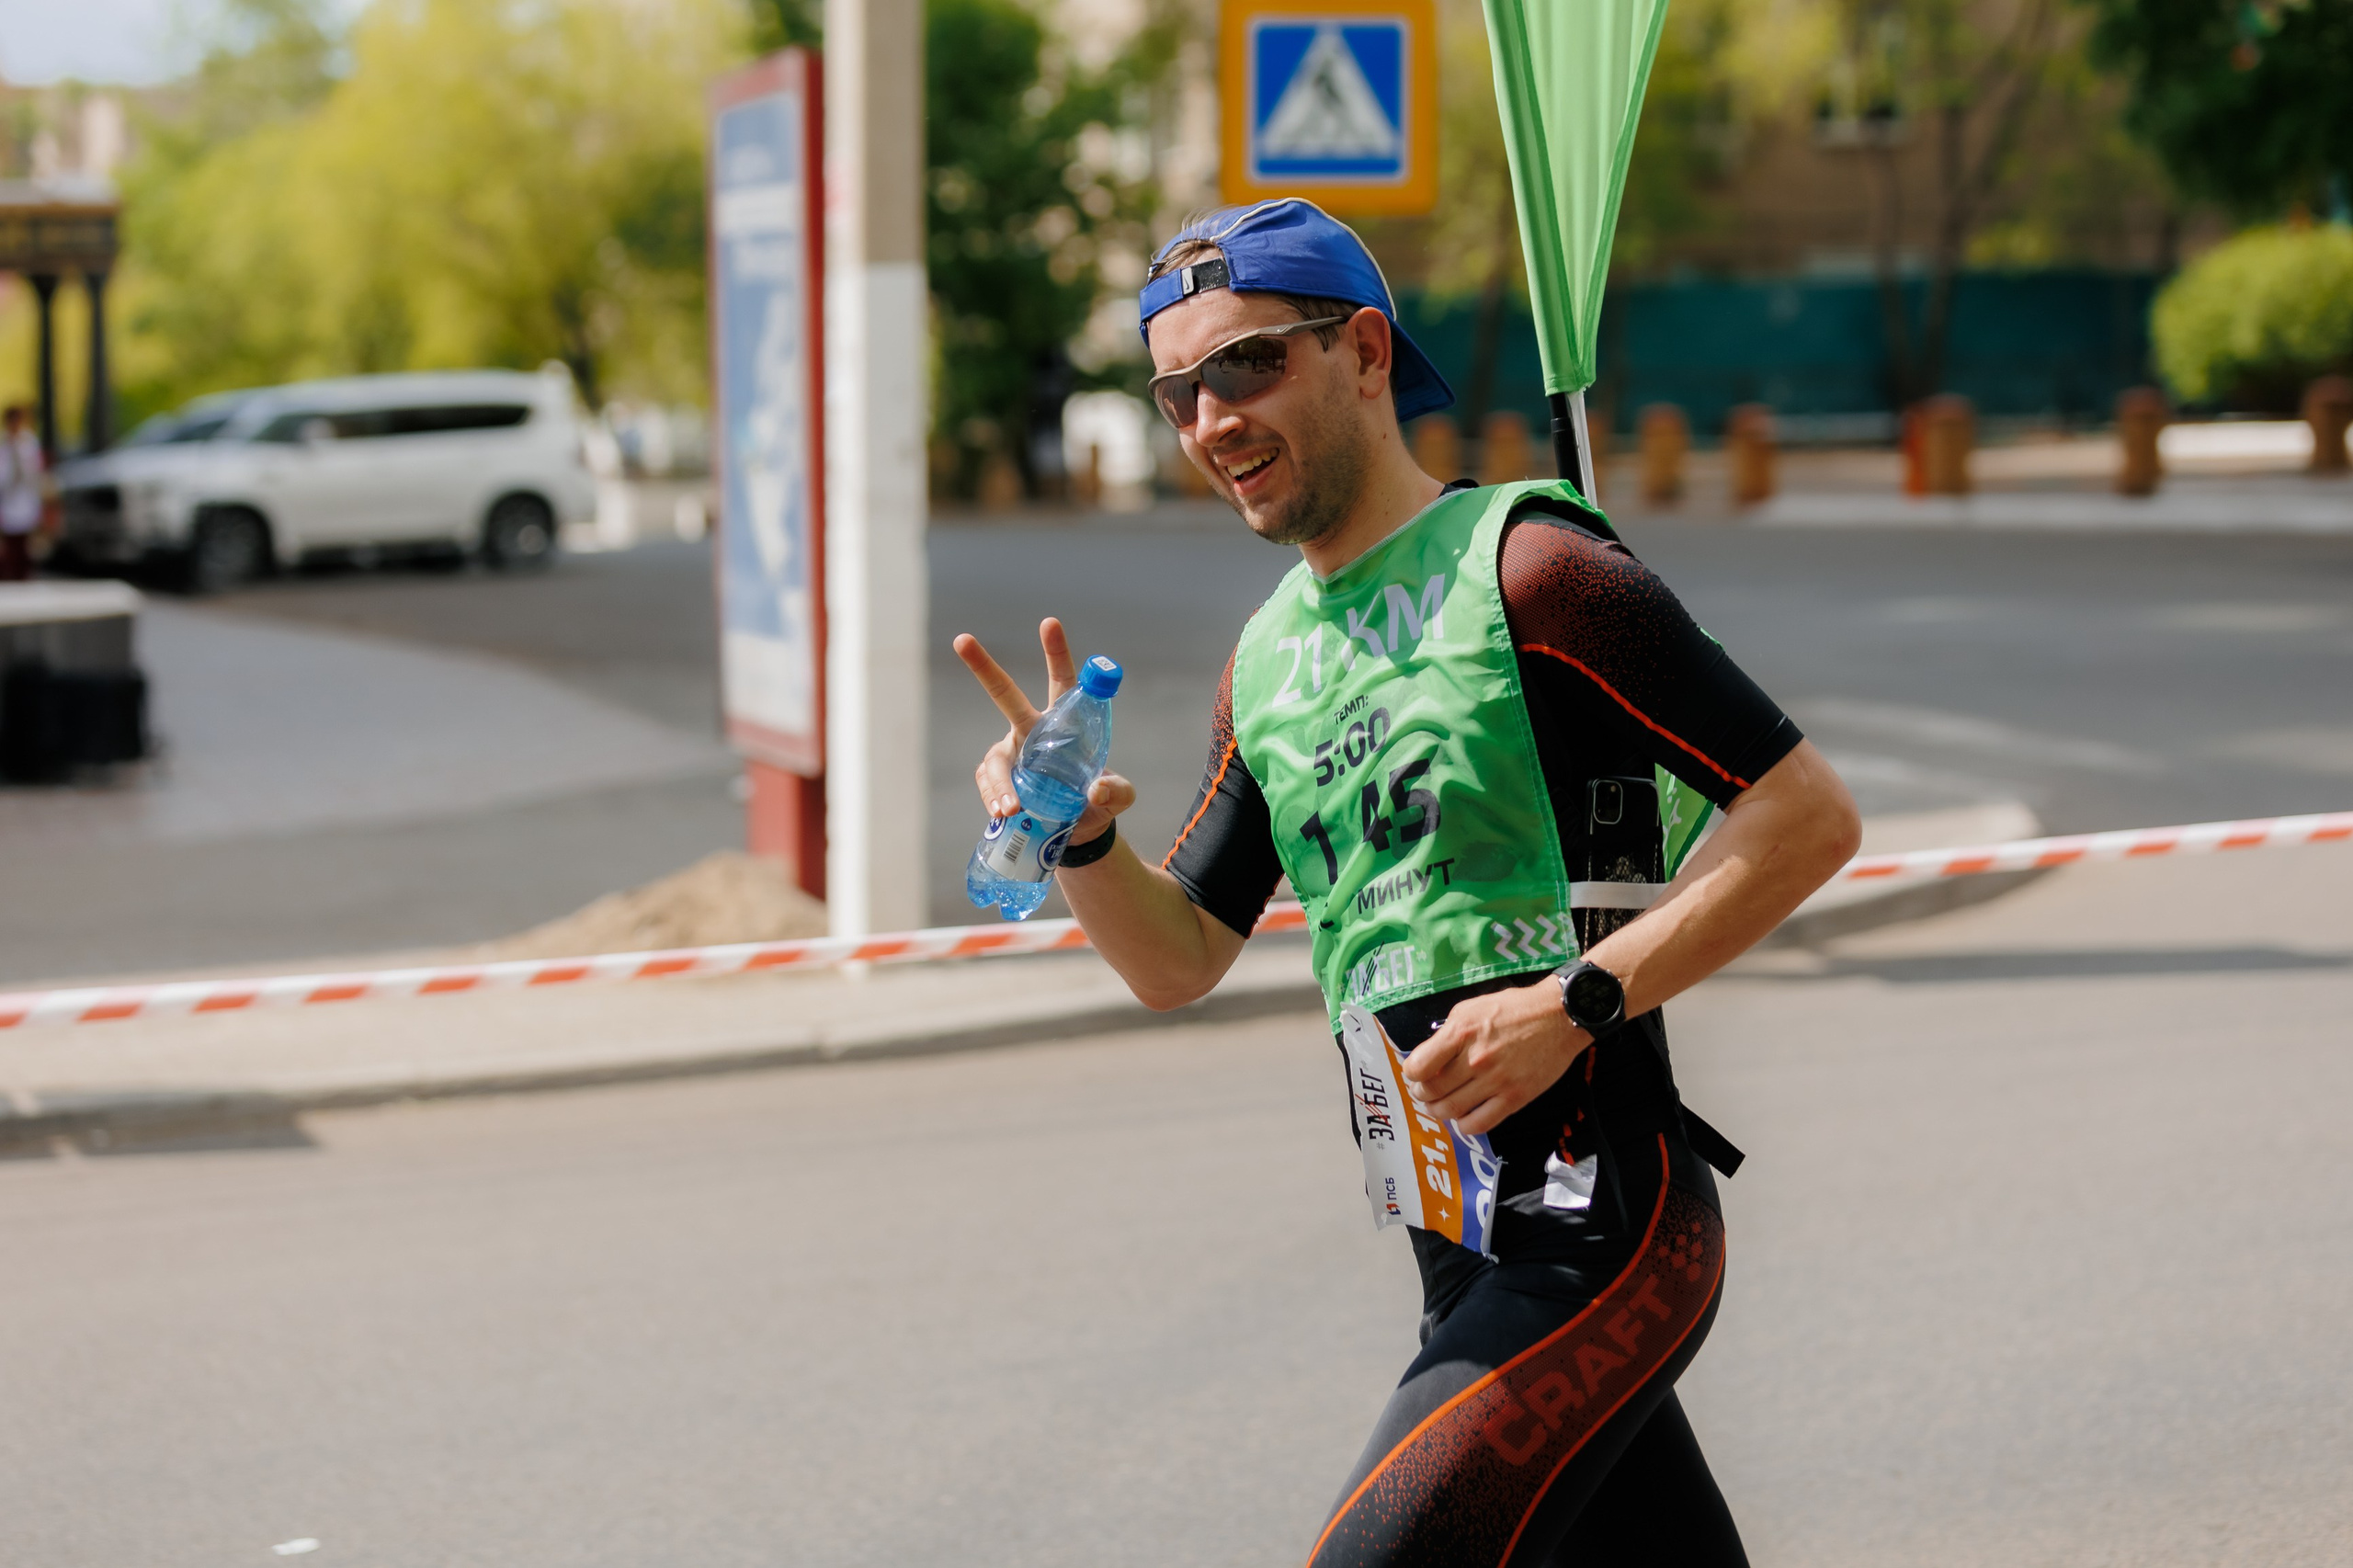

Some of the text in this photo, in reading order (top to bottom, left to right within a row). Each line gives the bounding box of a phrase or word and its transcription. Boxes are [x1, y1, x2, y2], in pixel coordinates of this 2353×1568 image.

[1272, 623, 1324, 709] 21
[1313, 706, 1391, 788] 5:00
[1334, 694, 1370, 725] ТЕМП:
[1360, 758, 1441, 853] 45
[1357, 858, 1456, 915] МИНУТ
[1385, 1176, 1397, 1200] ПСБ
[1483, 1273, 1671, 1466] CRAFT
